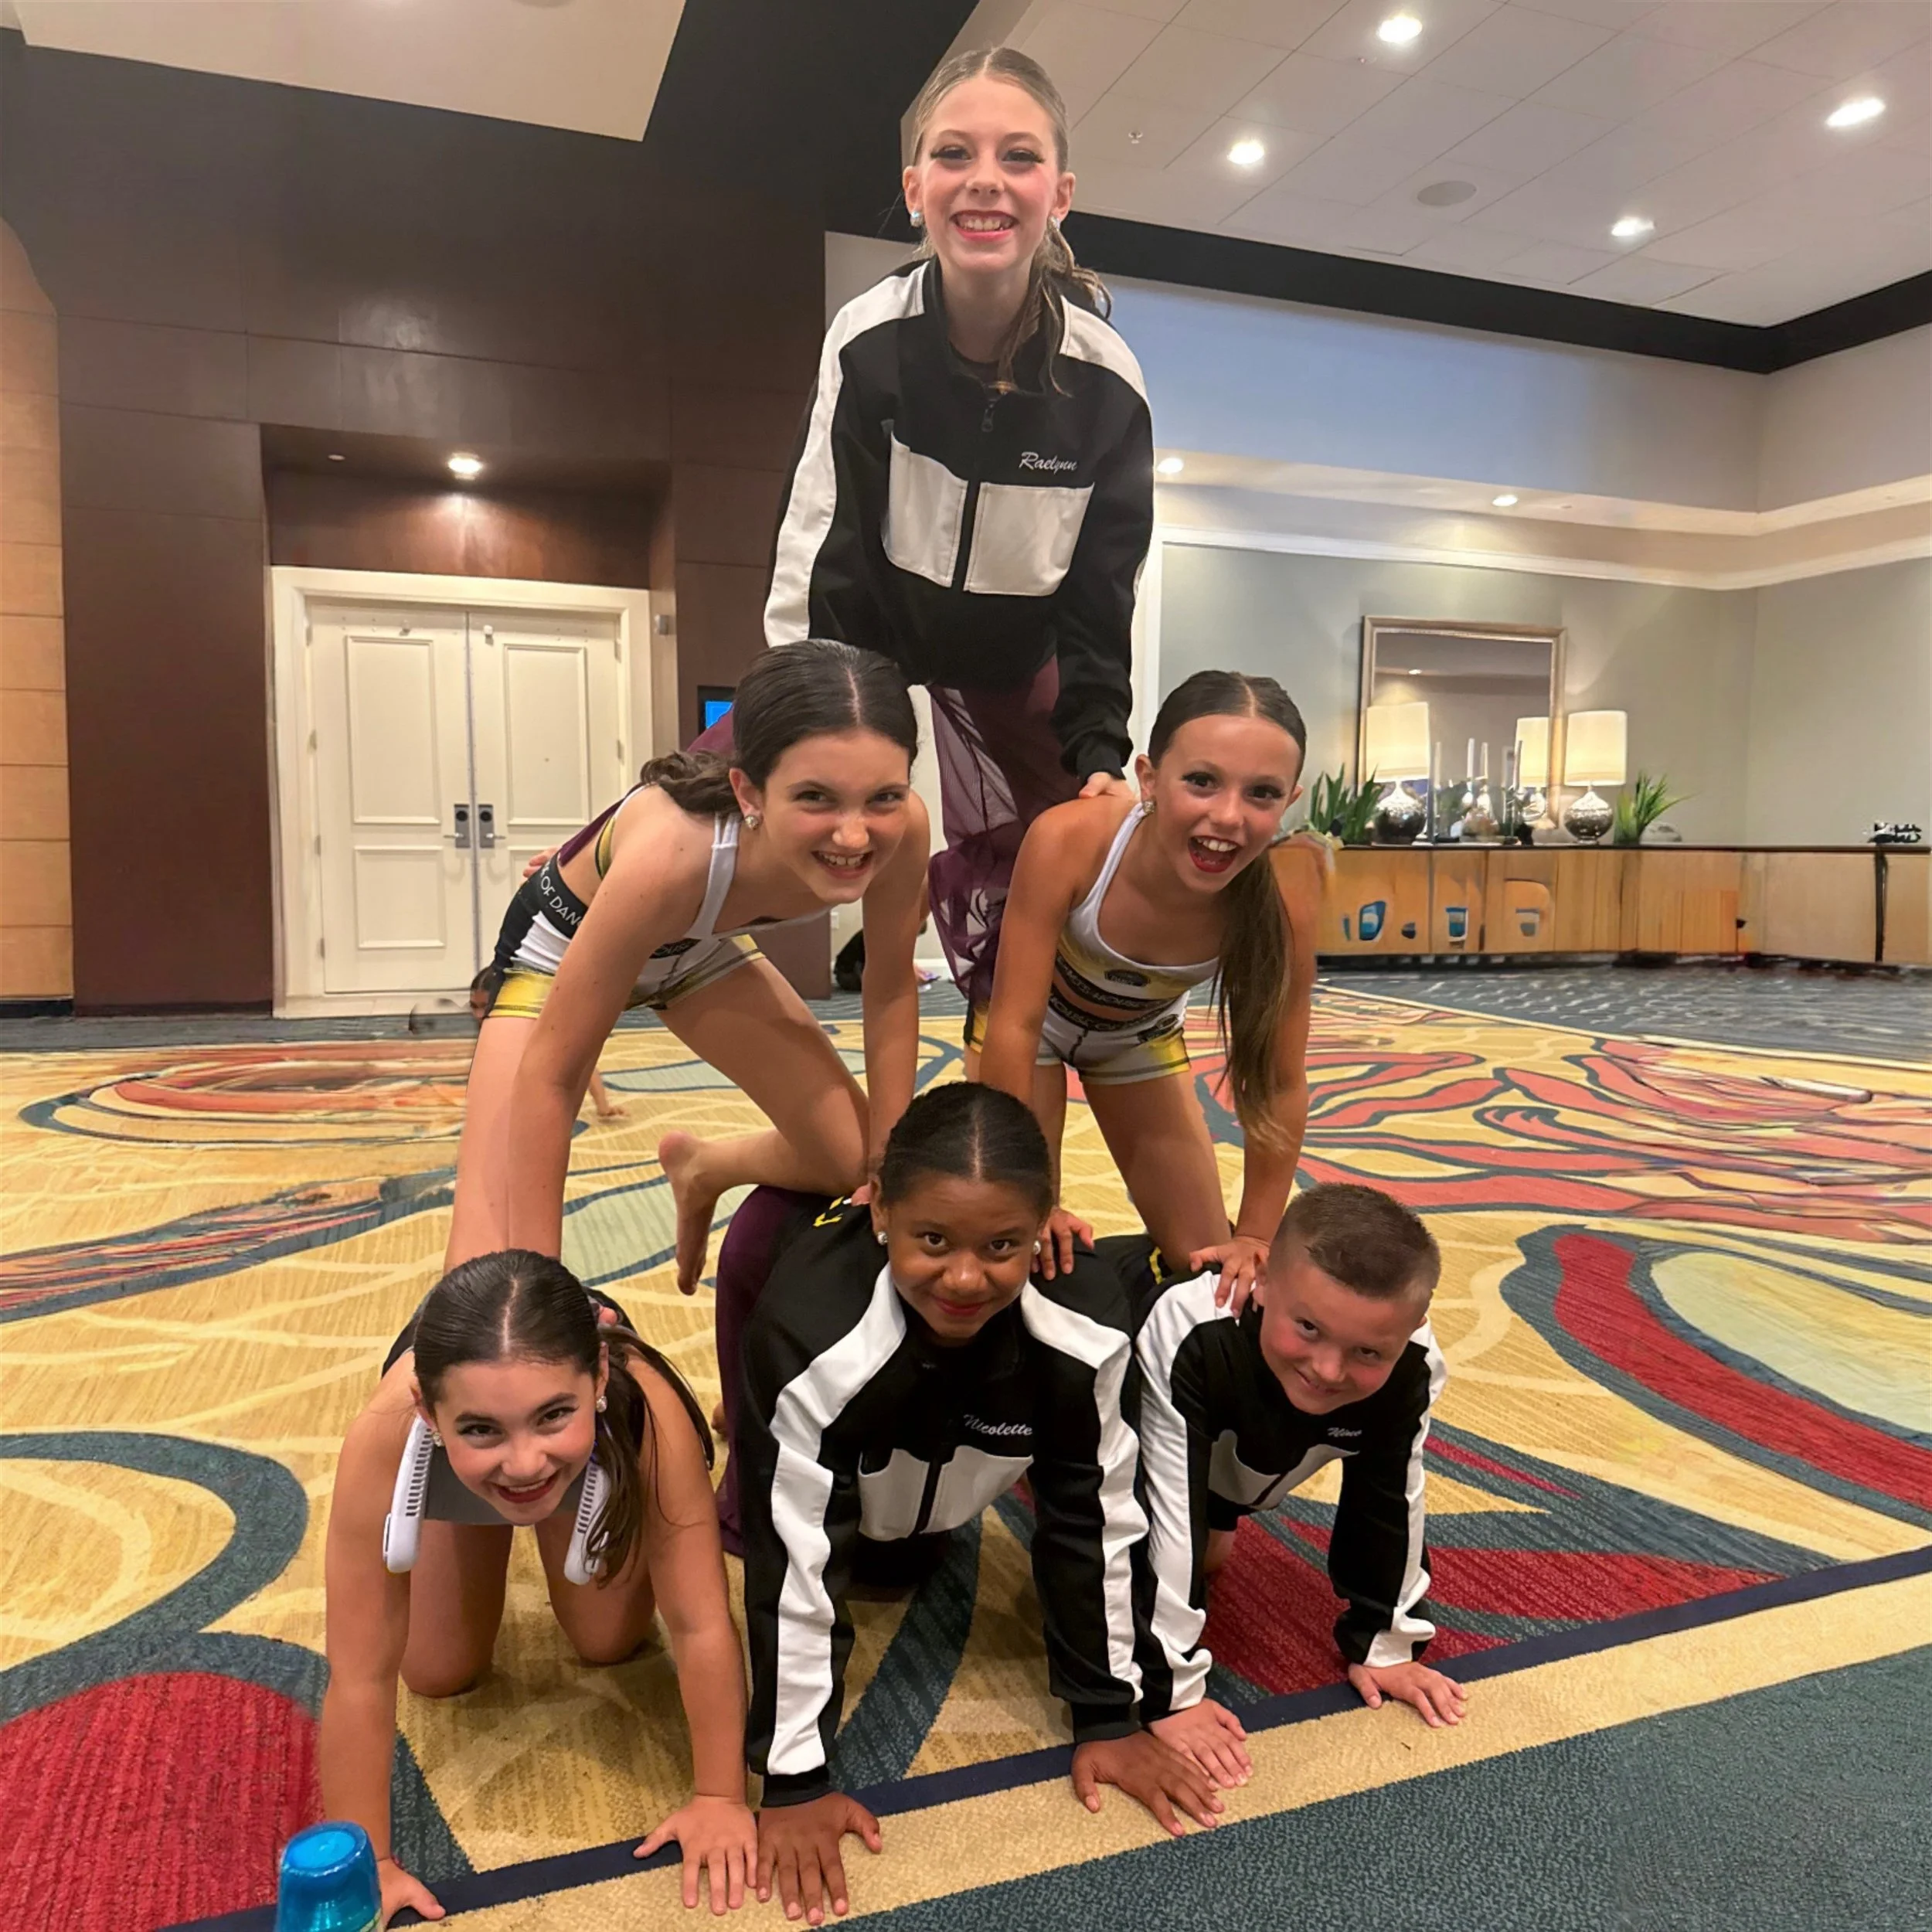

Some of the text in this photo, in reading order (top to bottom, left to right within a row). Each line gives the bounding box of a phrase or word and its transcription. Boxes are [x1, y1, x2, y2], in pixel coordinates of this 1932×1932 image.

[1019, 451, 1078, 475] Raelynn
[540, 875, 556, 896] OF
[549, 896, 583, 927] DAN
[963, 1413, 1033, 1436] Nicolette
